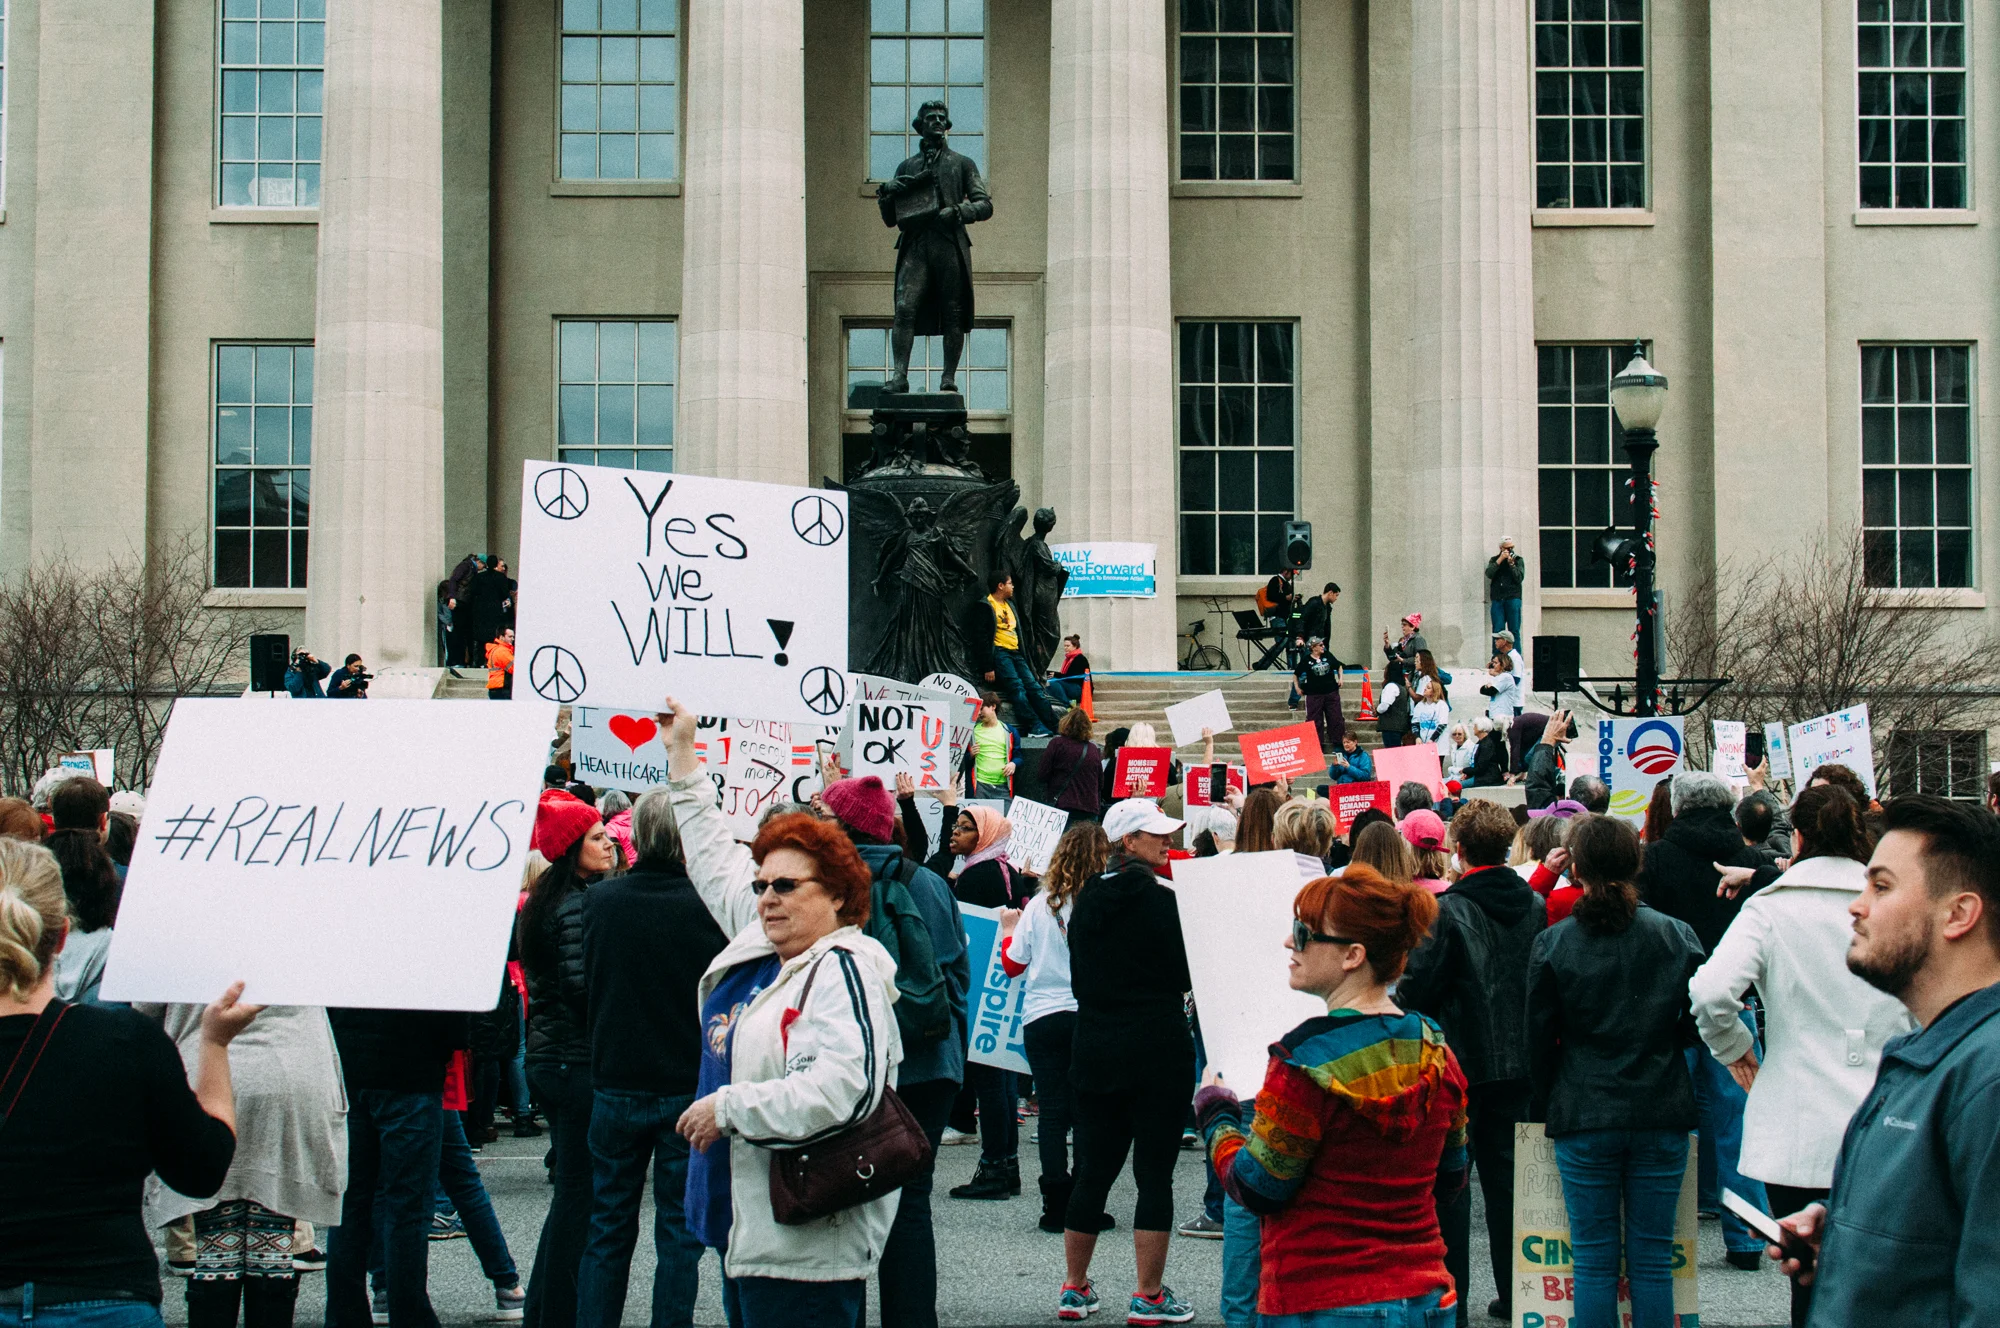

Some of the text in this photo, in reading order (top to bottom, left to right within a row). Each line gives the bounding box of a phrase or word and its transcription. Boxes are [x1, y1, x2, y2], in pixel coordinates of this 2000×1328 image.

[624, 477, 748, 560] Yes
[1054, 550, 1091, 563] RALLY
[1063, 562, 1144, 575] ove Forward
[637, 562, 713, 602] We
[611, 600, 795, 667] WILL!
[863, 681, 890, 700] WE
[933, 675, 971, 697] NO PA
[578, 706, 599, 728] I
[859, 703, 926, 732] NOT
[1825, 718, 1837, 736] IS
[740, 740, 786, 766] energy
[863, 736, 909, 766] OK
[1257, 740, 1285, 752] MOMS
[1259, 746, 1298, 759] DEMAND
[1598, 721, 1614, 790] HOPE
[579, 751, 669, 785] HEALTHCARE!
[1261, 754, 1295, 766] ACTION
[1339, 794, 1360, 803] MOMS
[1340, 801, 1371, 811] DEMAND
[1012, 800, 1068, 835] RALLY FOR
[1011, 823, 1049, 851] SOCIAL
